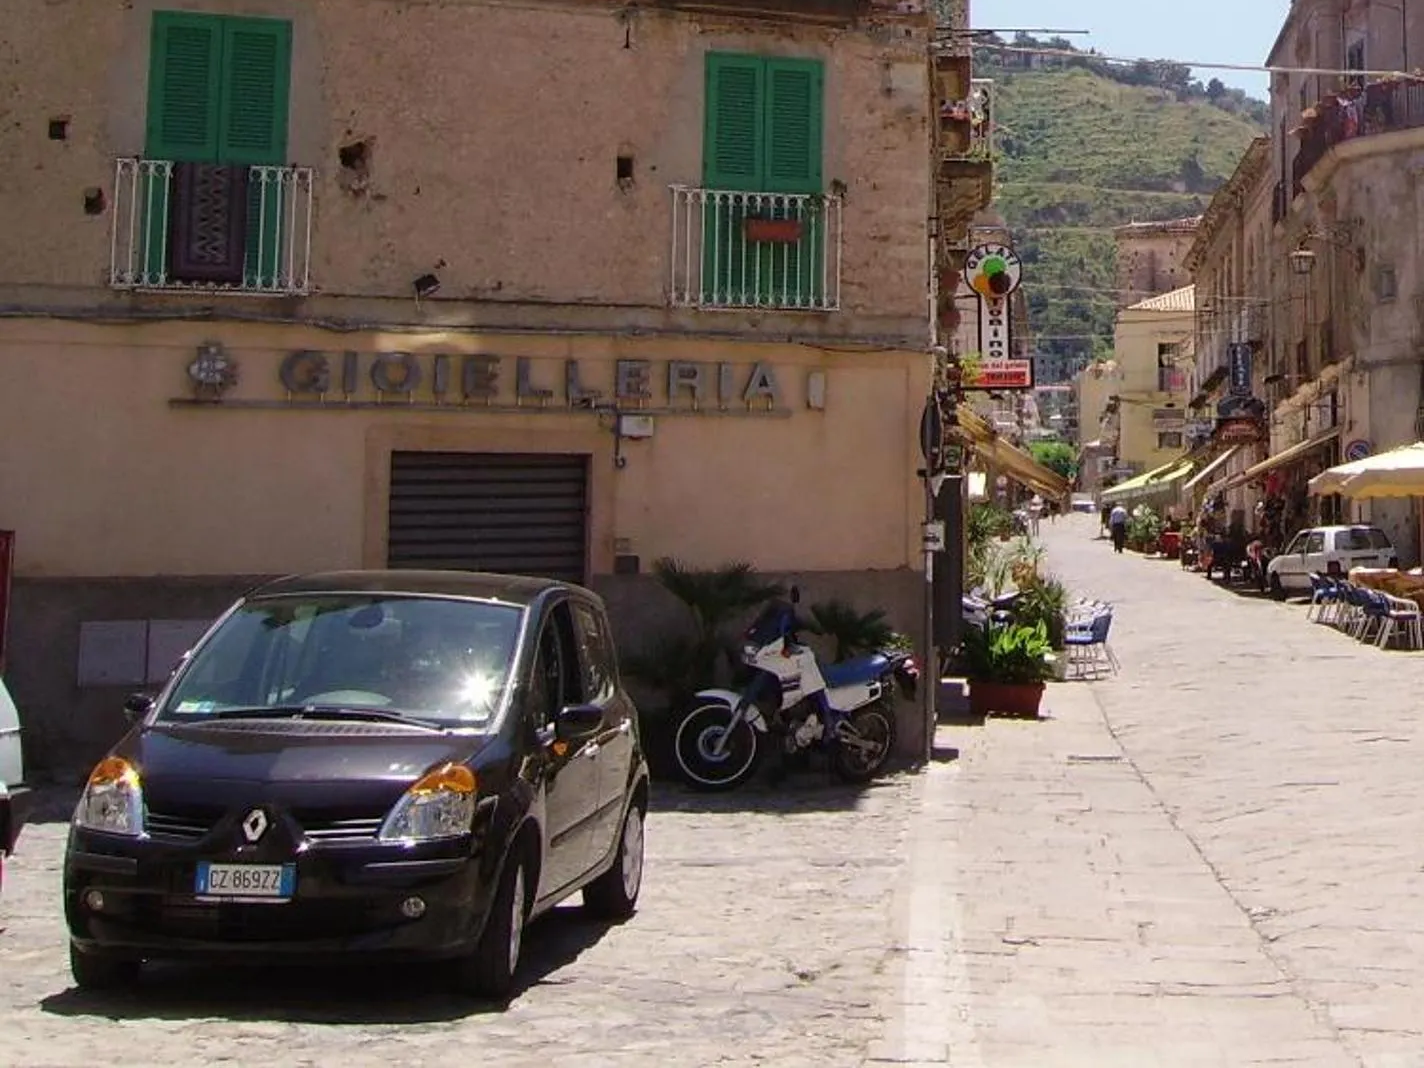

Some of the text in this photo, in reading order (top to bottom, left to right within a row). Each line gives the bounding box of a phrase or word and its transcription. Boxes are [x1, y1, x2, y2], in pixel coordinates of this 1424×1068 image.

[967, 245, 1020, 269] GELATI
[279, 348, 783, 406] GIOIELLERIA
[210, 870, 280, 889] CZ 869ZZ
